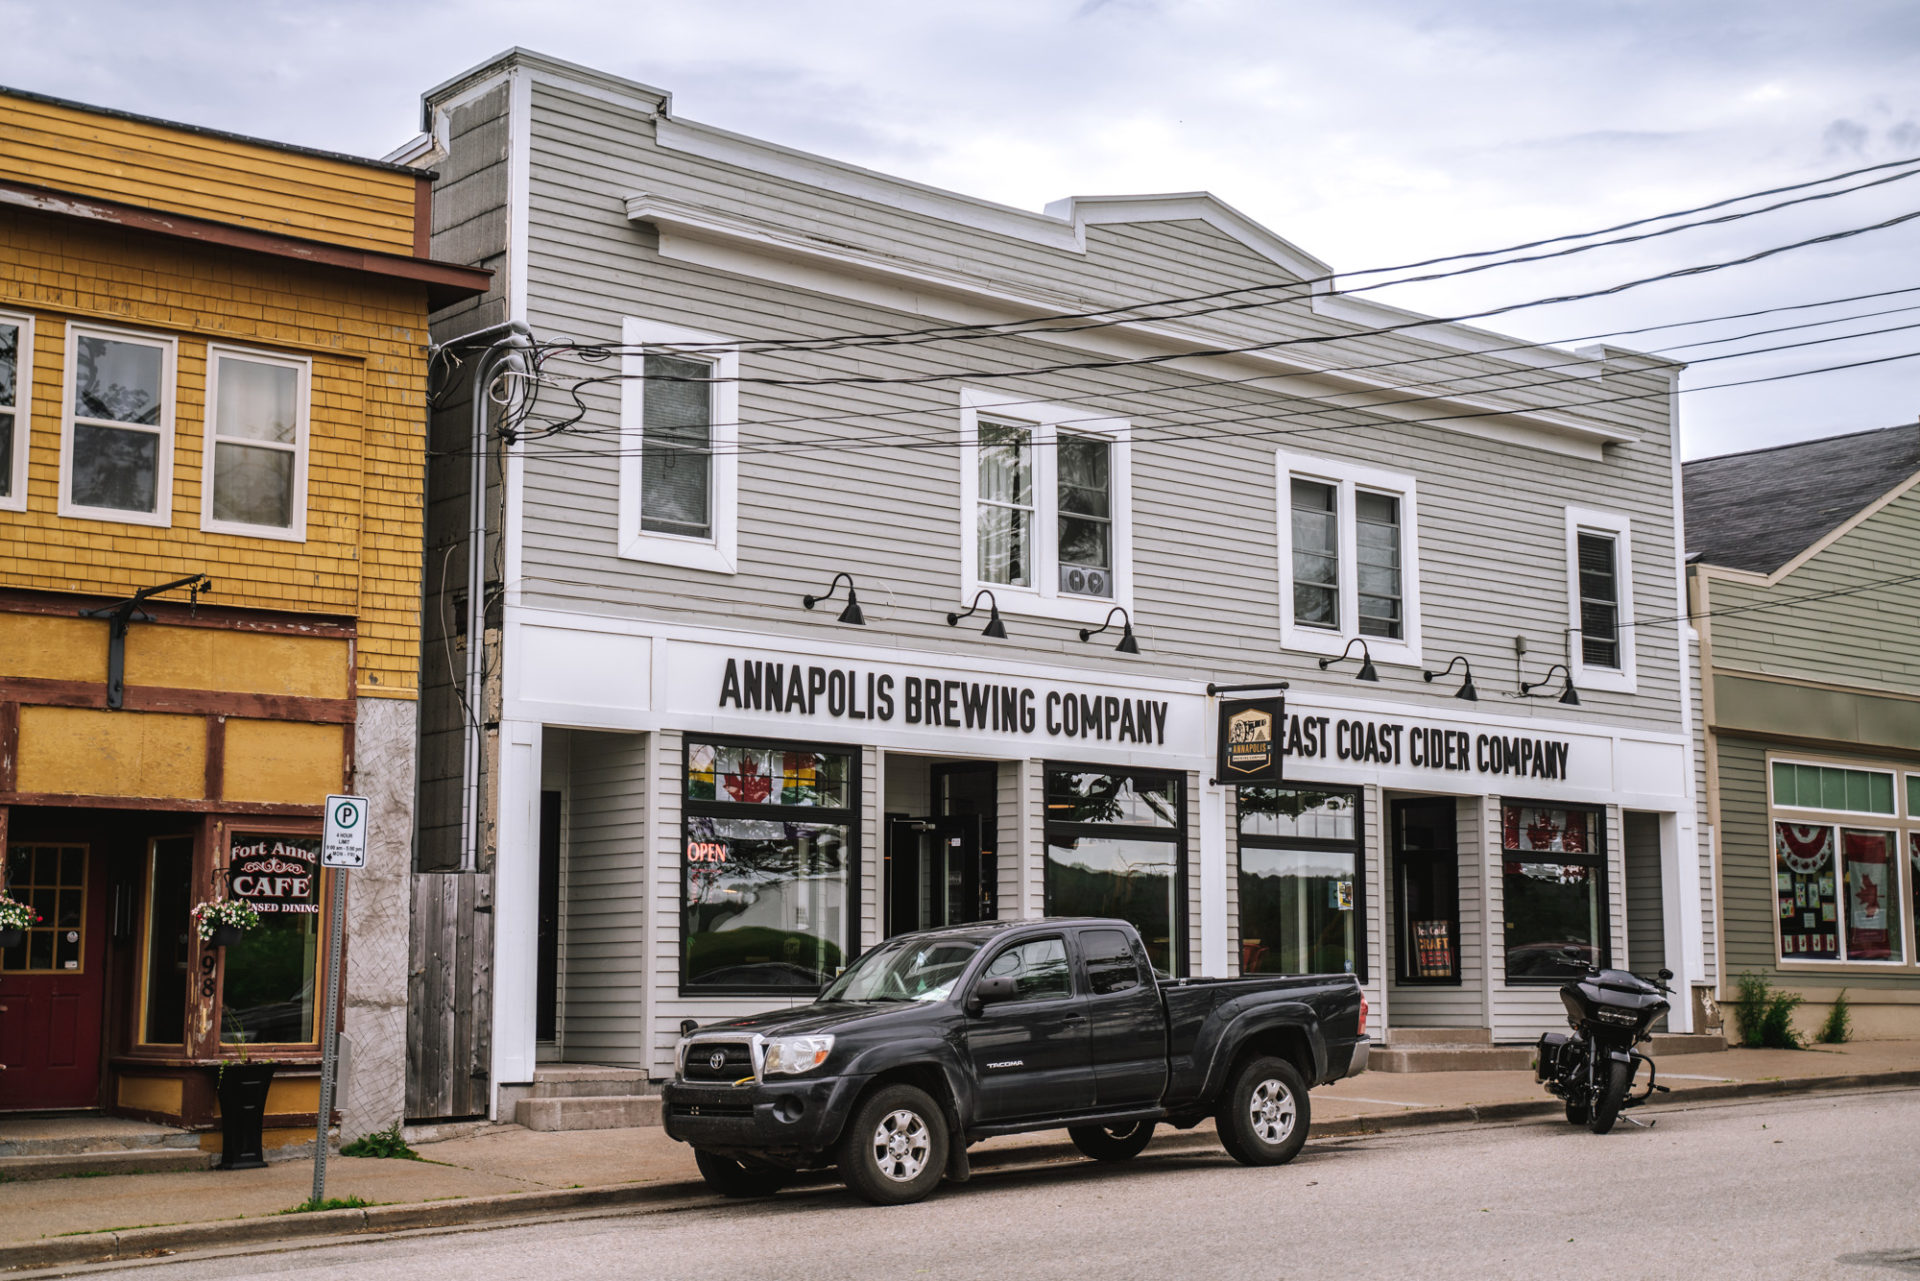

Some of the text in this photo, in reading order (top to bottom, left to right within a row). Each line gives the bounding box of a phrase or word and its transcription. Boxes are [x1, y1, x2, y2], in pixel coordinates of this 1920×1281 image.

[719, 658, 1168, 745] ANNAPOLIS BREWING COMPANY
[1232, 743, 1267, 754] ANNAPOLIS
[1336, 718, 1404, 764] COAST
[1409, 726, 1471, 771] CIDER
[1477, 734, 1569, 780] COMPANY
[342, 807, 352, 823] P
[231, 841, 316, 864] Fort Anne
[687, 842, 726, 862] OPEN
[232, 874, 313, 897] CAFÉ
[281, 903, 319, 913] DINING
[1419, 937, 1449, 950] CRAFT
[1421, 951, 1450, 966] BEER
[986, 1060, 1024, 1069] TACOMA
